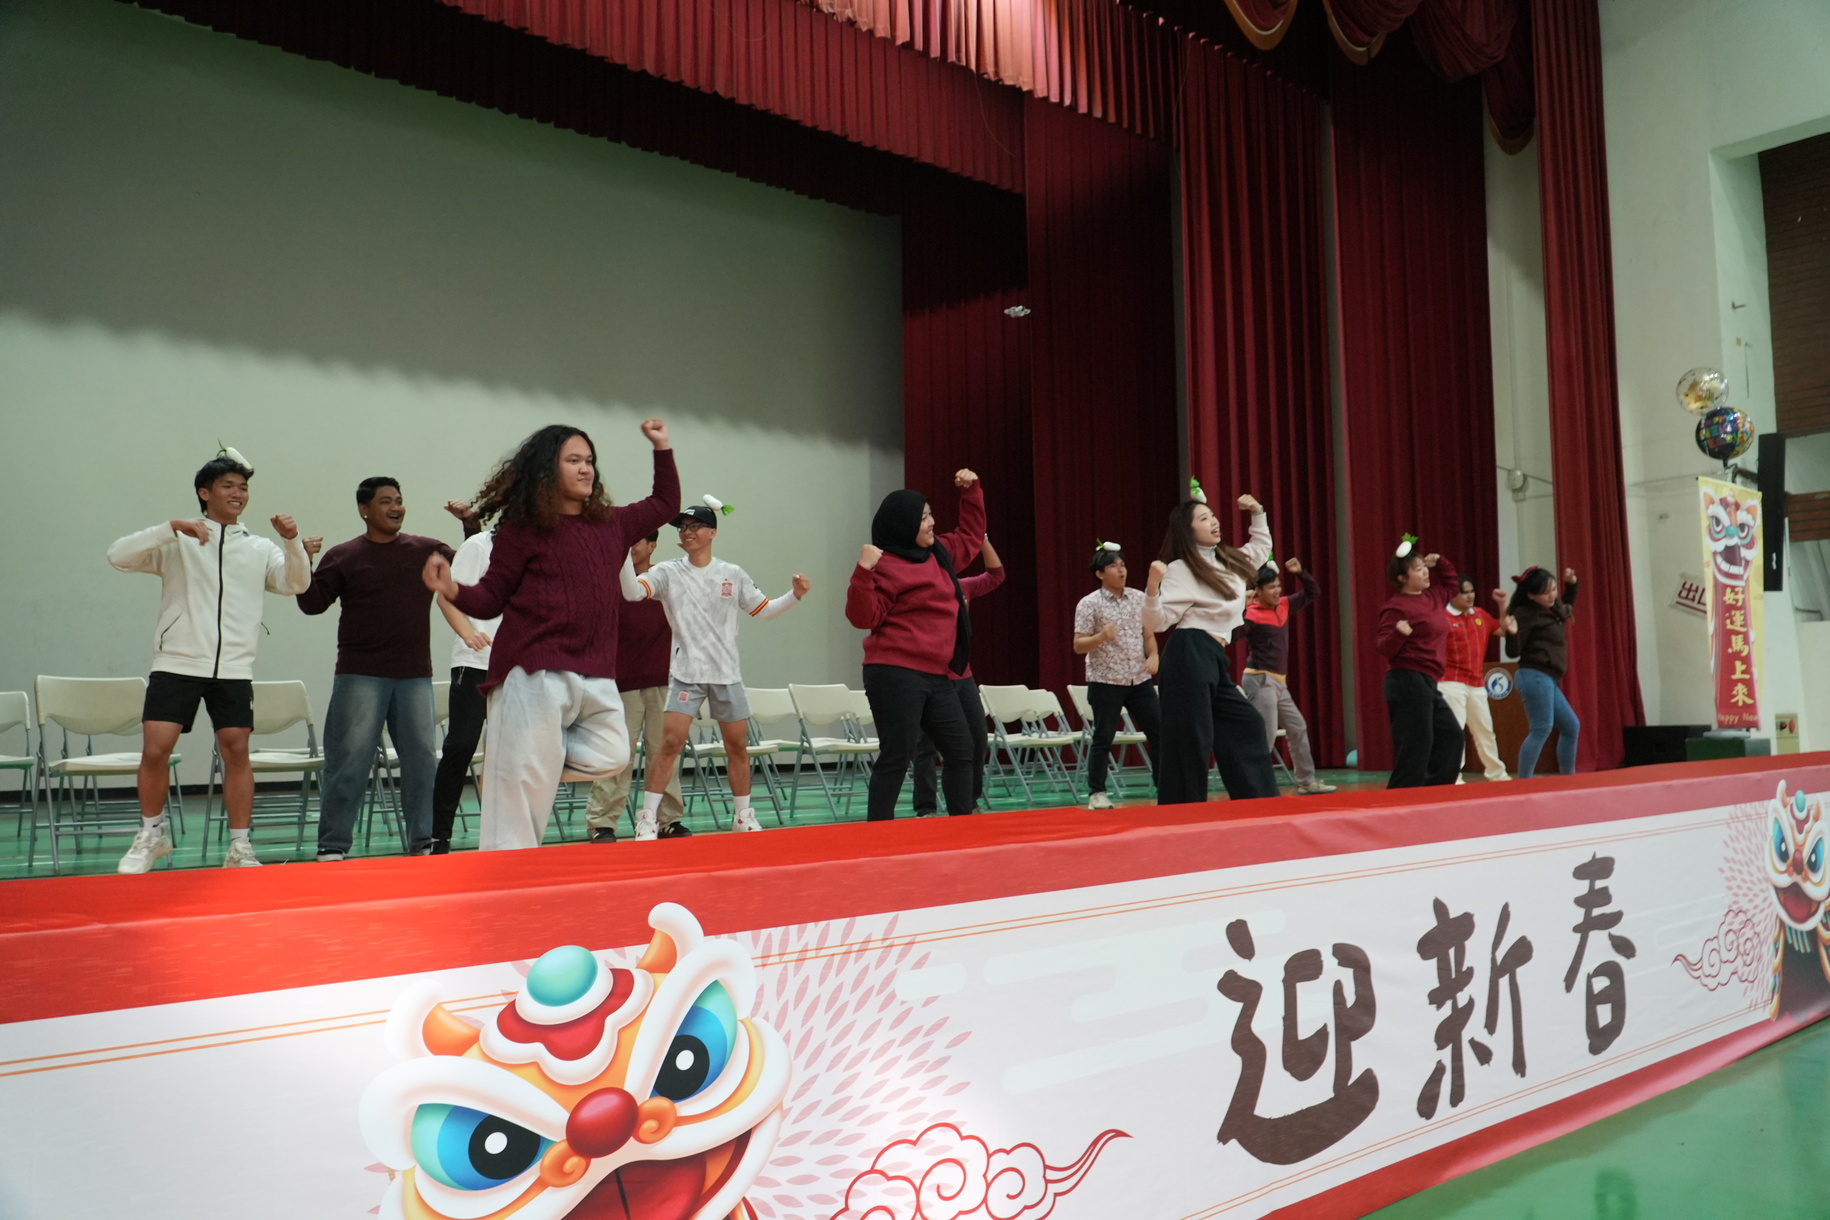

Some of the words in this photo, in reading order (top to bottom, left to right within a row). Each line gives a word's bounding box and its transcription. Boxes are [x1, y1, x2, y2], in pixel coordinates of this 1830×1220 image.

[1723, 586, 1755, 706] 好運馬上來
[1217, 851, 1637, 1165] 迎新春
